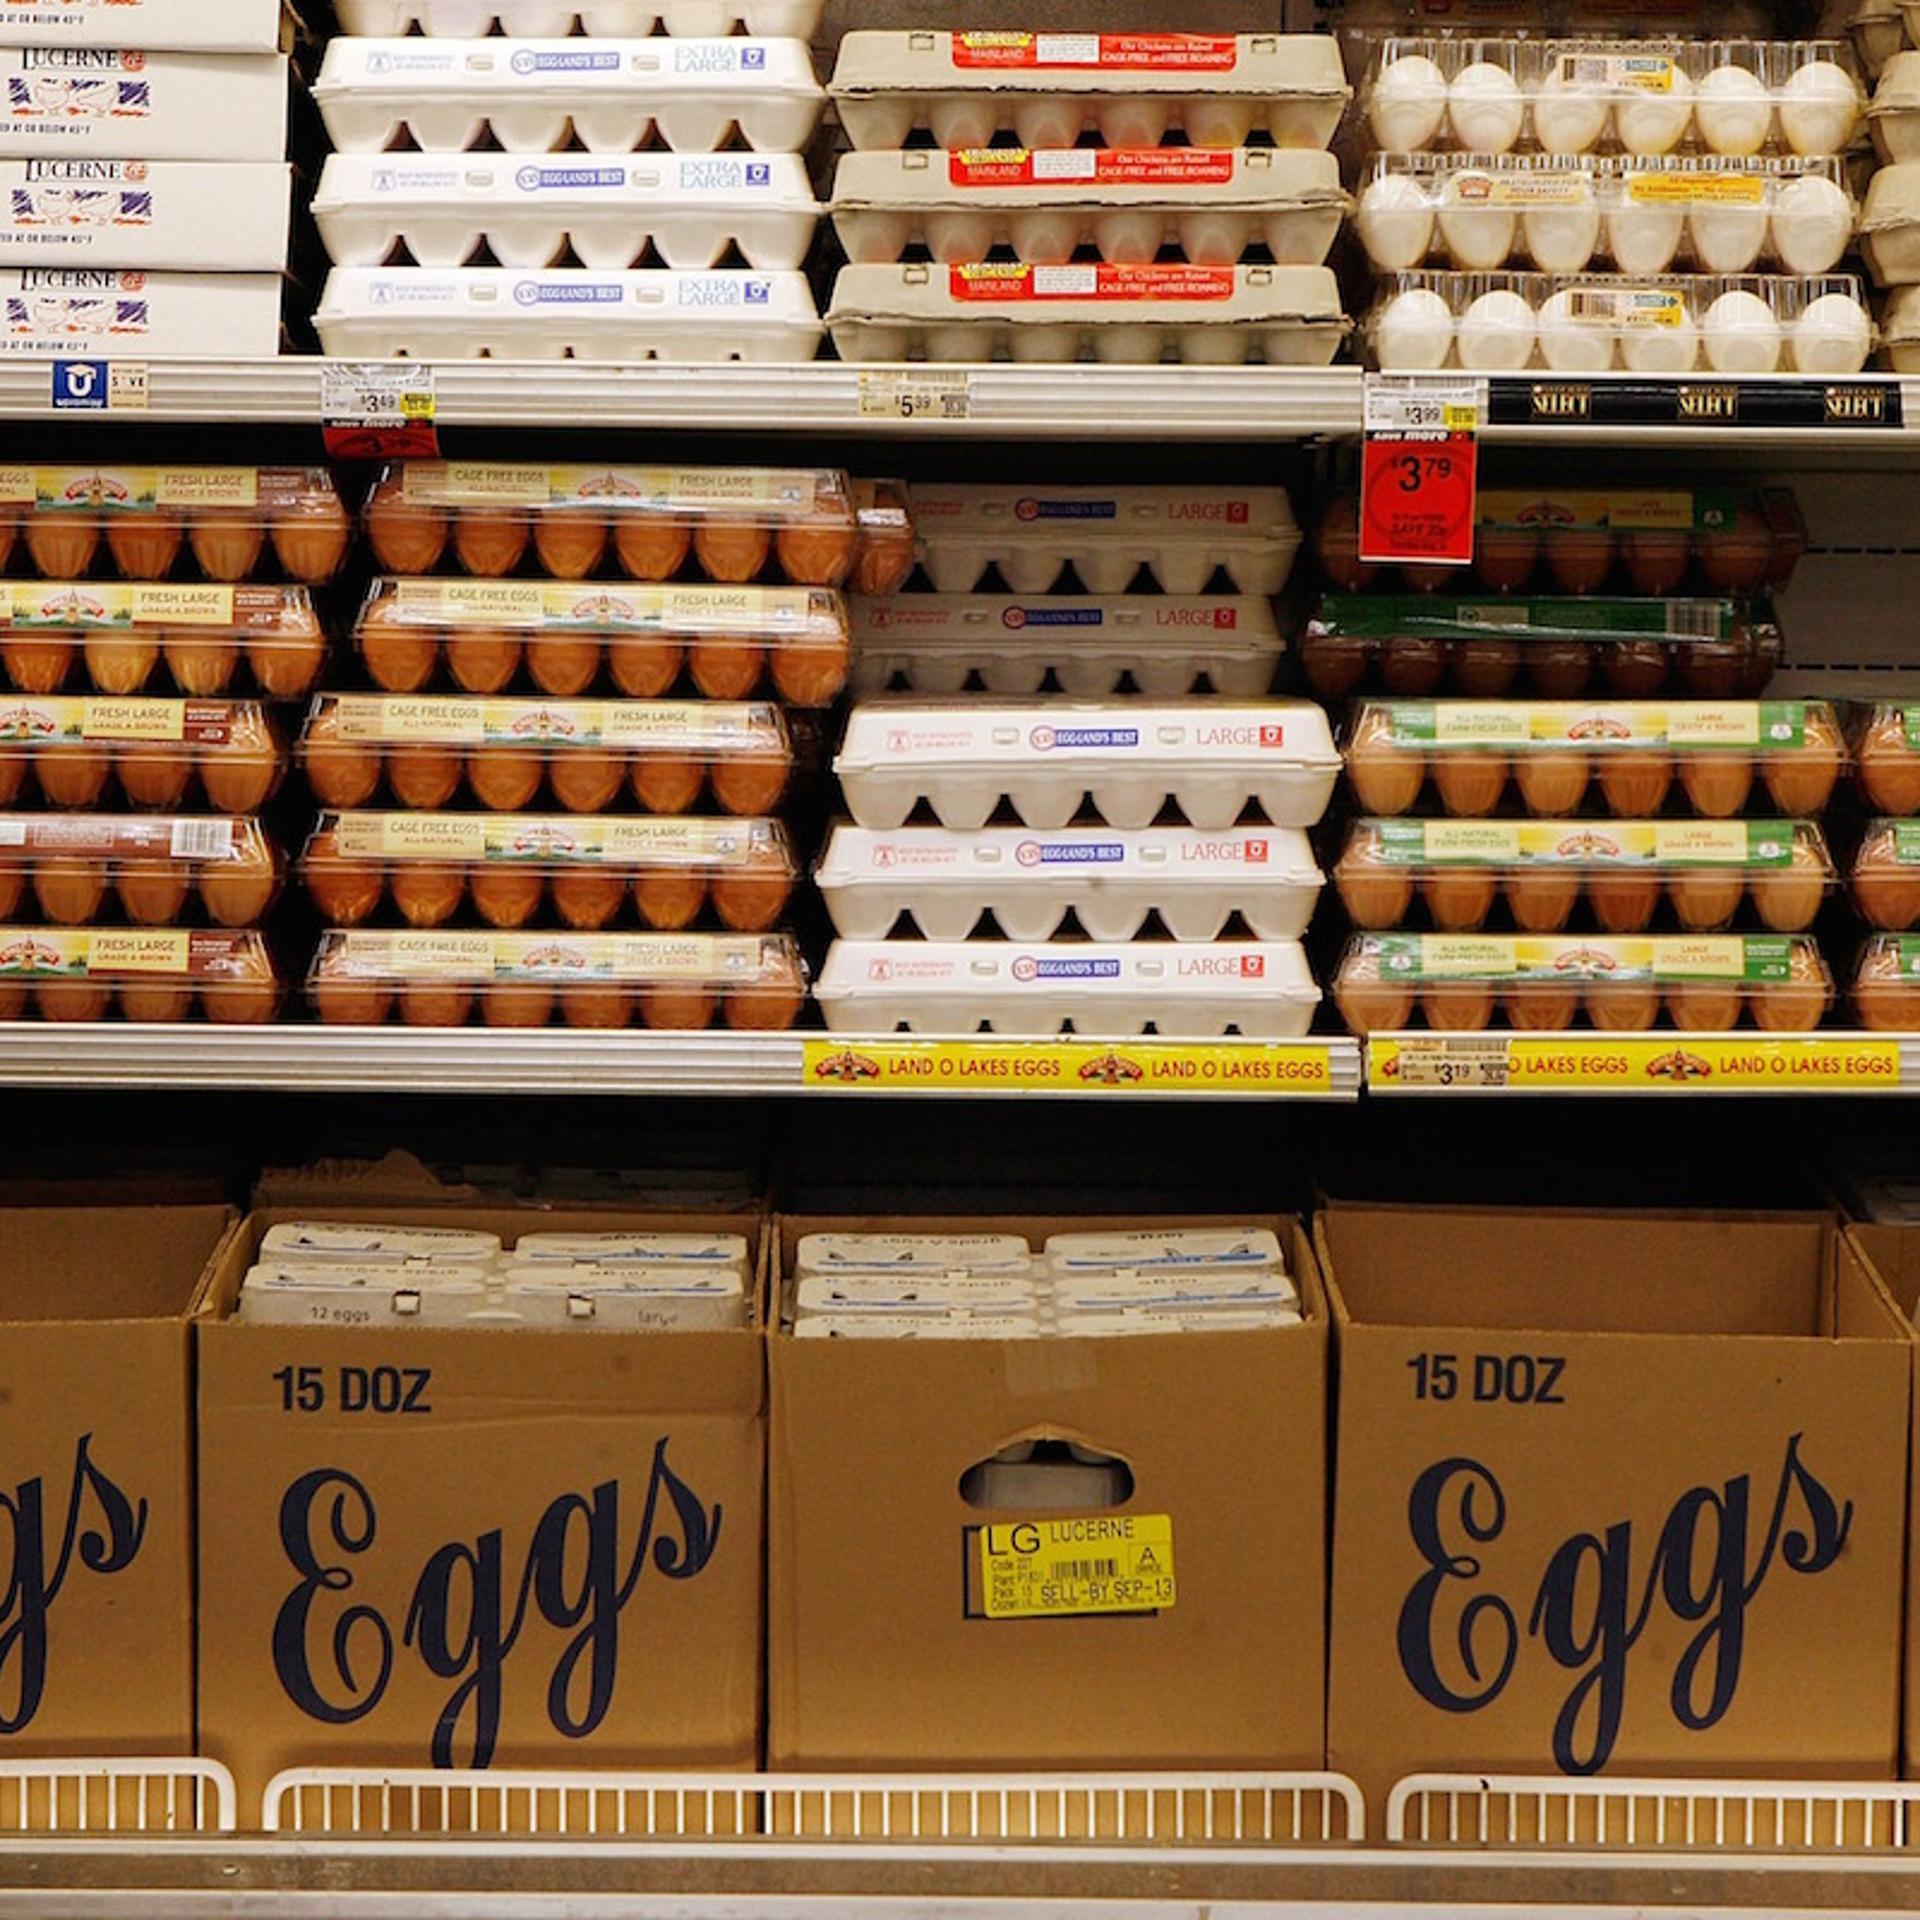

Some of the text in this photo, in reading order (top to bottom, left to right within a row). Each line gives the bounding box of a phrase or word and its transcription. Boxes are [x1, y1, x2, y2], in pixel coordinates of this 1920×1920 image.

[22, 48, 119, 70] LUCERNE
[675, 45, 736, 59] EXTRA
[593, 53, 618, 67] BEST
[674, 58, 736, 72] LARGE
[25, 158, 121, 182] LUCERNE
[680, 161, 741, 175] EXTRA
[599, 169, 623, 183] BEST
[680, 174, 741, 189] LARGE
[21, 269, 116, 291] LUCERNE
[678, 279, 740, 293] EXTRA
[597, 286, 620, 300] BEST
[678, 291, 740, 305] LARGE
[165, 474, 202, 486] FRESH
[206, 474, 244, 486] LARGE
[455, 469, 545, 482] CAGE FREE EGGS
[679, 475, 753, 488] FRESH LARGE
[1169, 504, 1226, 519] LARGE
[141, 591, 220, 604] FRESH LARGE
[449, 588, 539, 602] CAGE FREE EGGS
[673, 594, 747, 607] FRESH LARGE
[1156, 609, 1212, 625] LARGE
[92, 708, 170, 720] FRESH LARGE
[389, 705, 479, 719] CAGE FREE EGGS
[614, 711, 687, 722] FRESH LARGE
[1112, 731, 1137, 744] BEST
[1196, 729, 1257, 745] LARGE
[390, 821, 480, 834] CAGE FREE EGGS
[614, 826, 687, 838] FRESH LARGE
[1097, 847, 1122, 860] BEST
[1181, 843, 1242, 861] LARGE
[97, 939, 176, 952] FRESH LARGE
[1093, 961, 1118, 974] BEST
[1177, 959, 1238, 976] LARGE
[889, 1059, 1061, 1077] LAND O LAKES EGGS
[1152, 1061, 1323, 1078] LAND O LAKES EGGS
[1527, 1057, 1576, 1073] LAKES
[1581, 1057, 1628, 1074] EGGS
[1720, 1057, 1893, 1073] LAND O LAKES EGGS
[310, 1306, 371, 1323] 12 eggs
[1407, 1353, 1567, 1403] 15 DOZ
[273, 1366, 432, 1413] 15 DOZ
[987, 1518, 1135, 1556] LG LUCERNE
[1140, 1547, 1156, 1562] A
[1040, 1578, 1173, 1601] SELL-BY SEP-13
[272, 1436, 722, 1769] Eggs
[1396, 1431, 1854, 1776] Eggs
